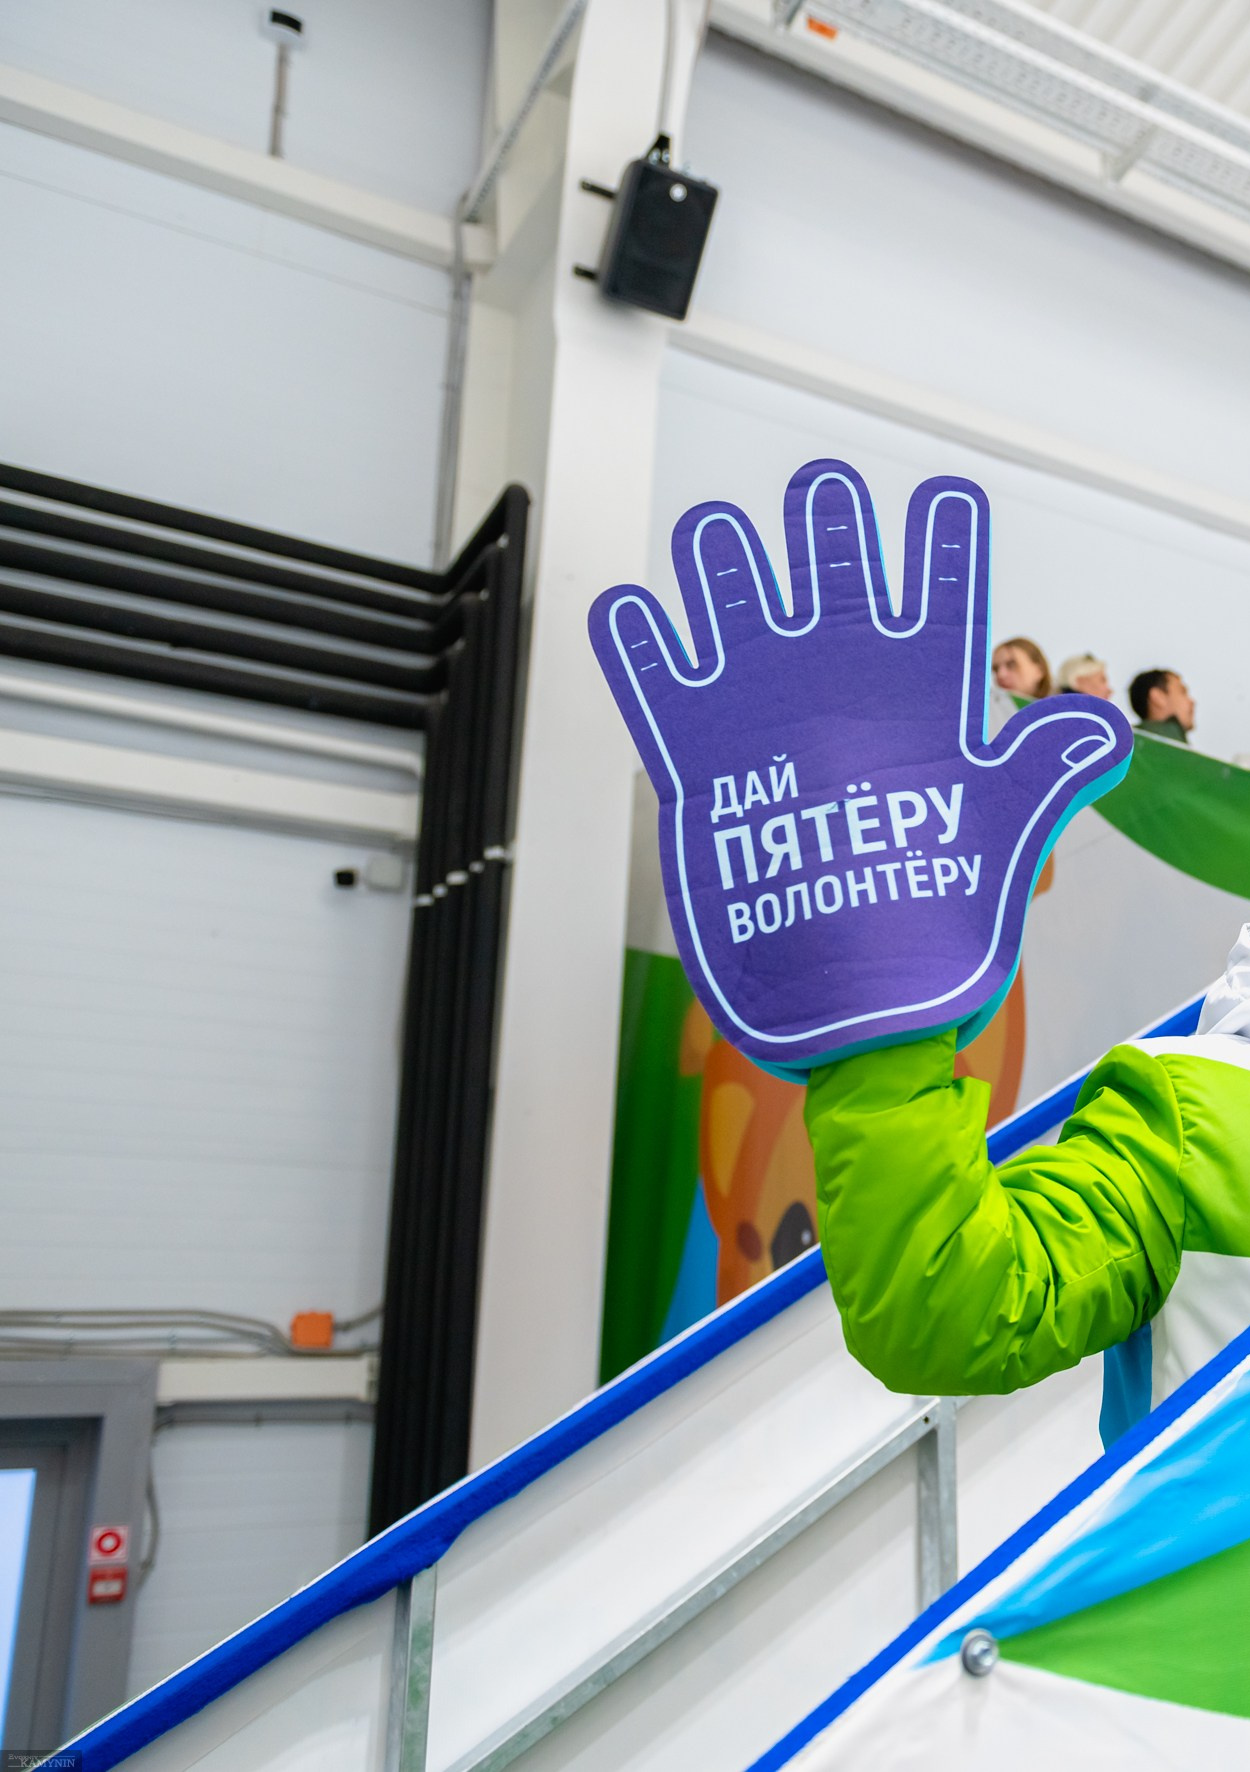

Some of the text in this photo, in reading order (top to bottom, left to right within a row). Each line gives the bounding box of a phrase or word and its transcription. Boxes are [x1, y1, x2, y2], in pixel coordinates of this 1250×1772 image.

[710, 753, 800, 824] ДАЙ
[713, 781, 965, 891] ПЯТЁРУ
[726, 849, 983, 945] ВОЛОНТЁРУ
